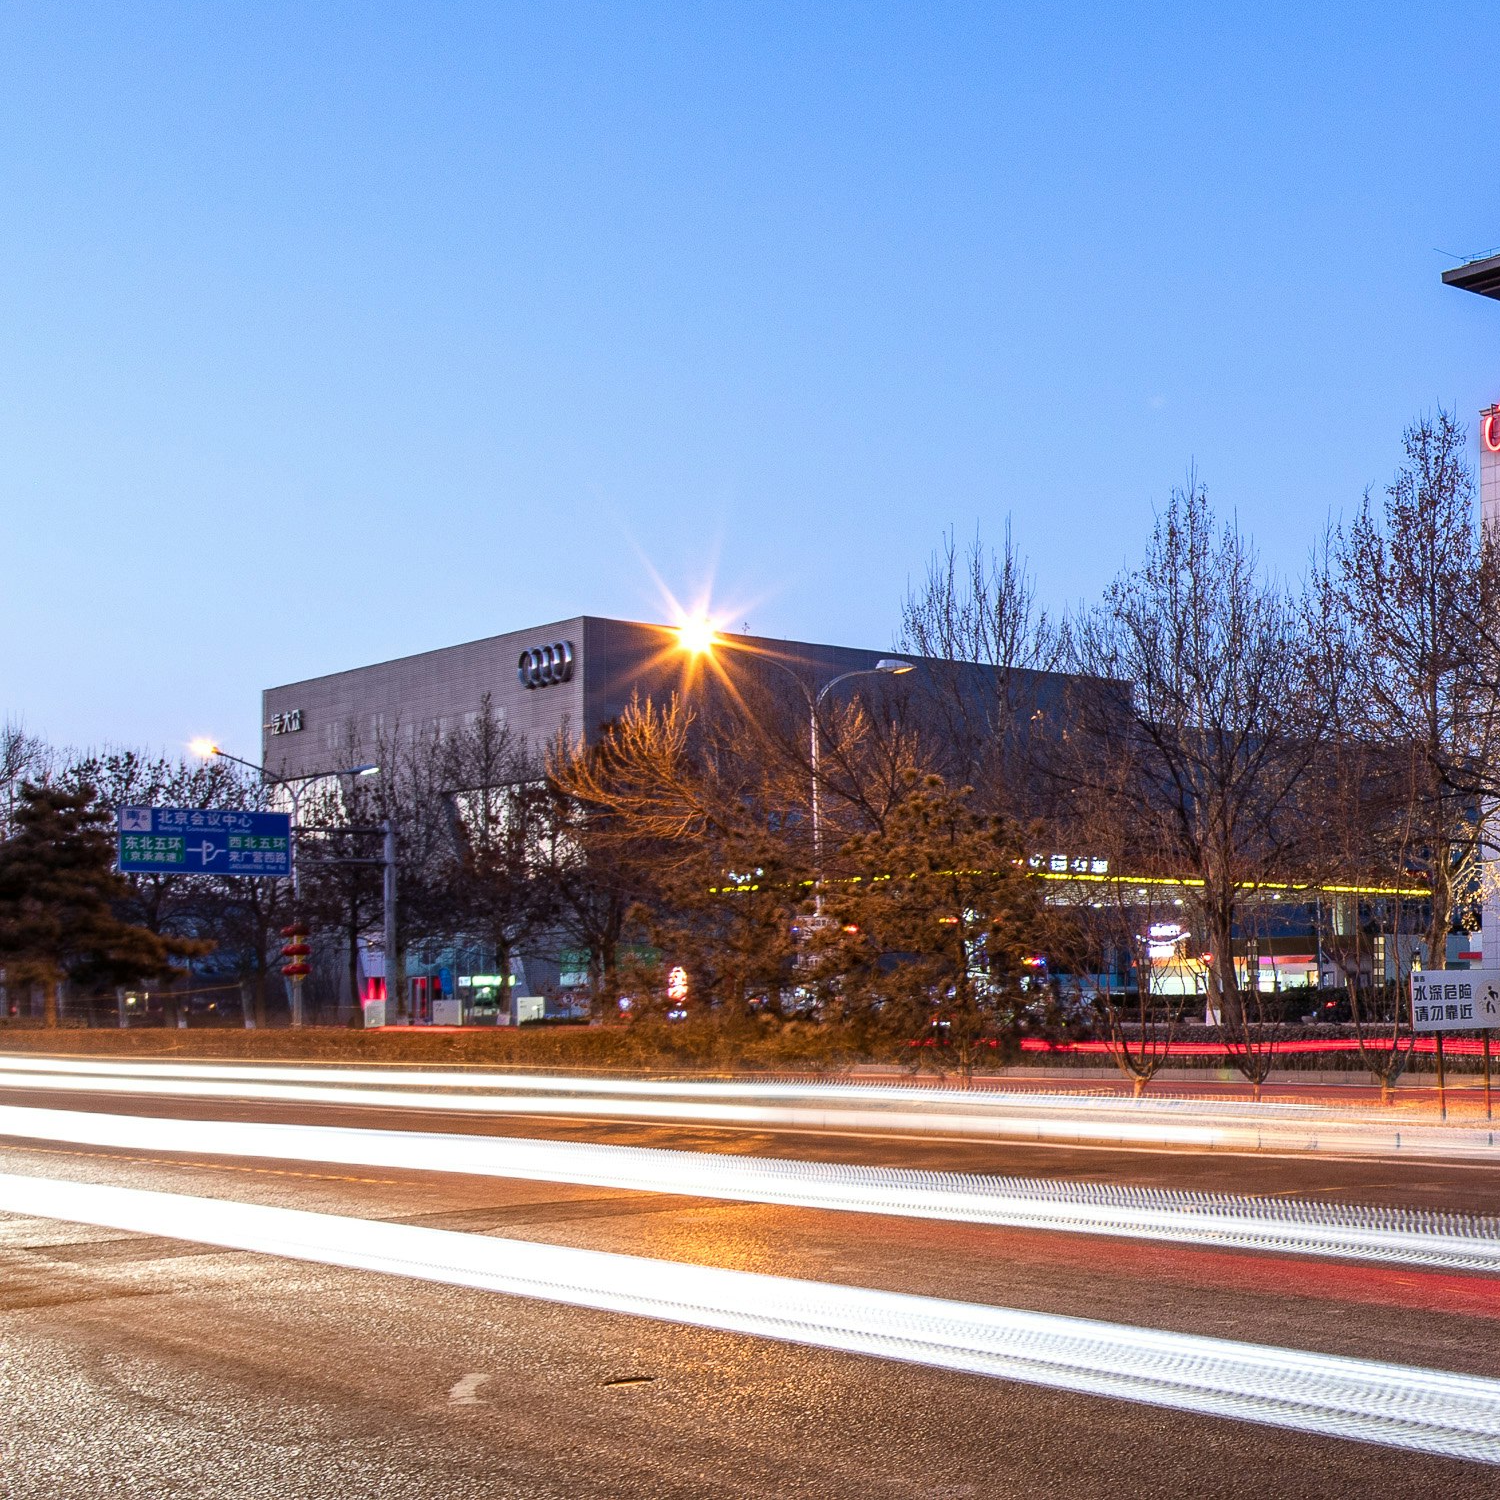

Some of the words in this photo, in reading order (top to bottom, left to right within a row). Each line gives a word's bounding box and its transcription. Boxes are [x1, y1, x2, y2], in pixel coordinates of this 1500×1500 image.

[158, 810, 253, 828] 北京会议中心
[125, 836, 182, 851] 东北五环
[229, 836, 286, 850] 西北五环
[229, 851, 287, 864] 来广营西路
[1413, 983, 1472, 1001] 水深危险
[1414, 1003, 1473, 1022] 请勿靠近
